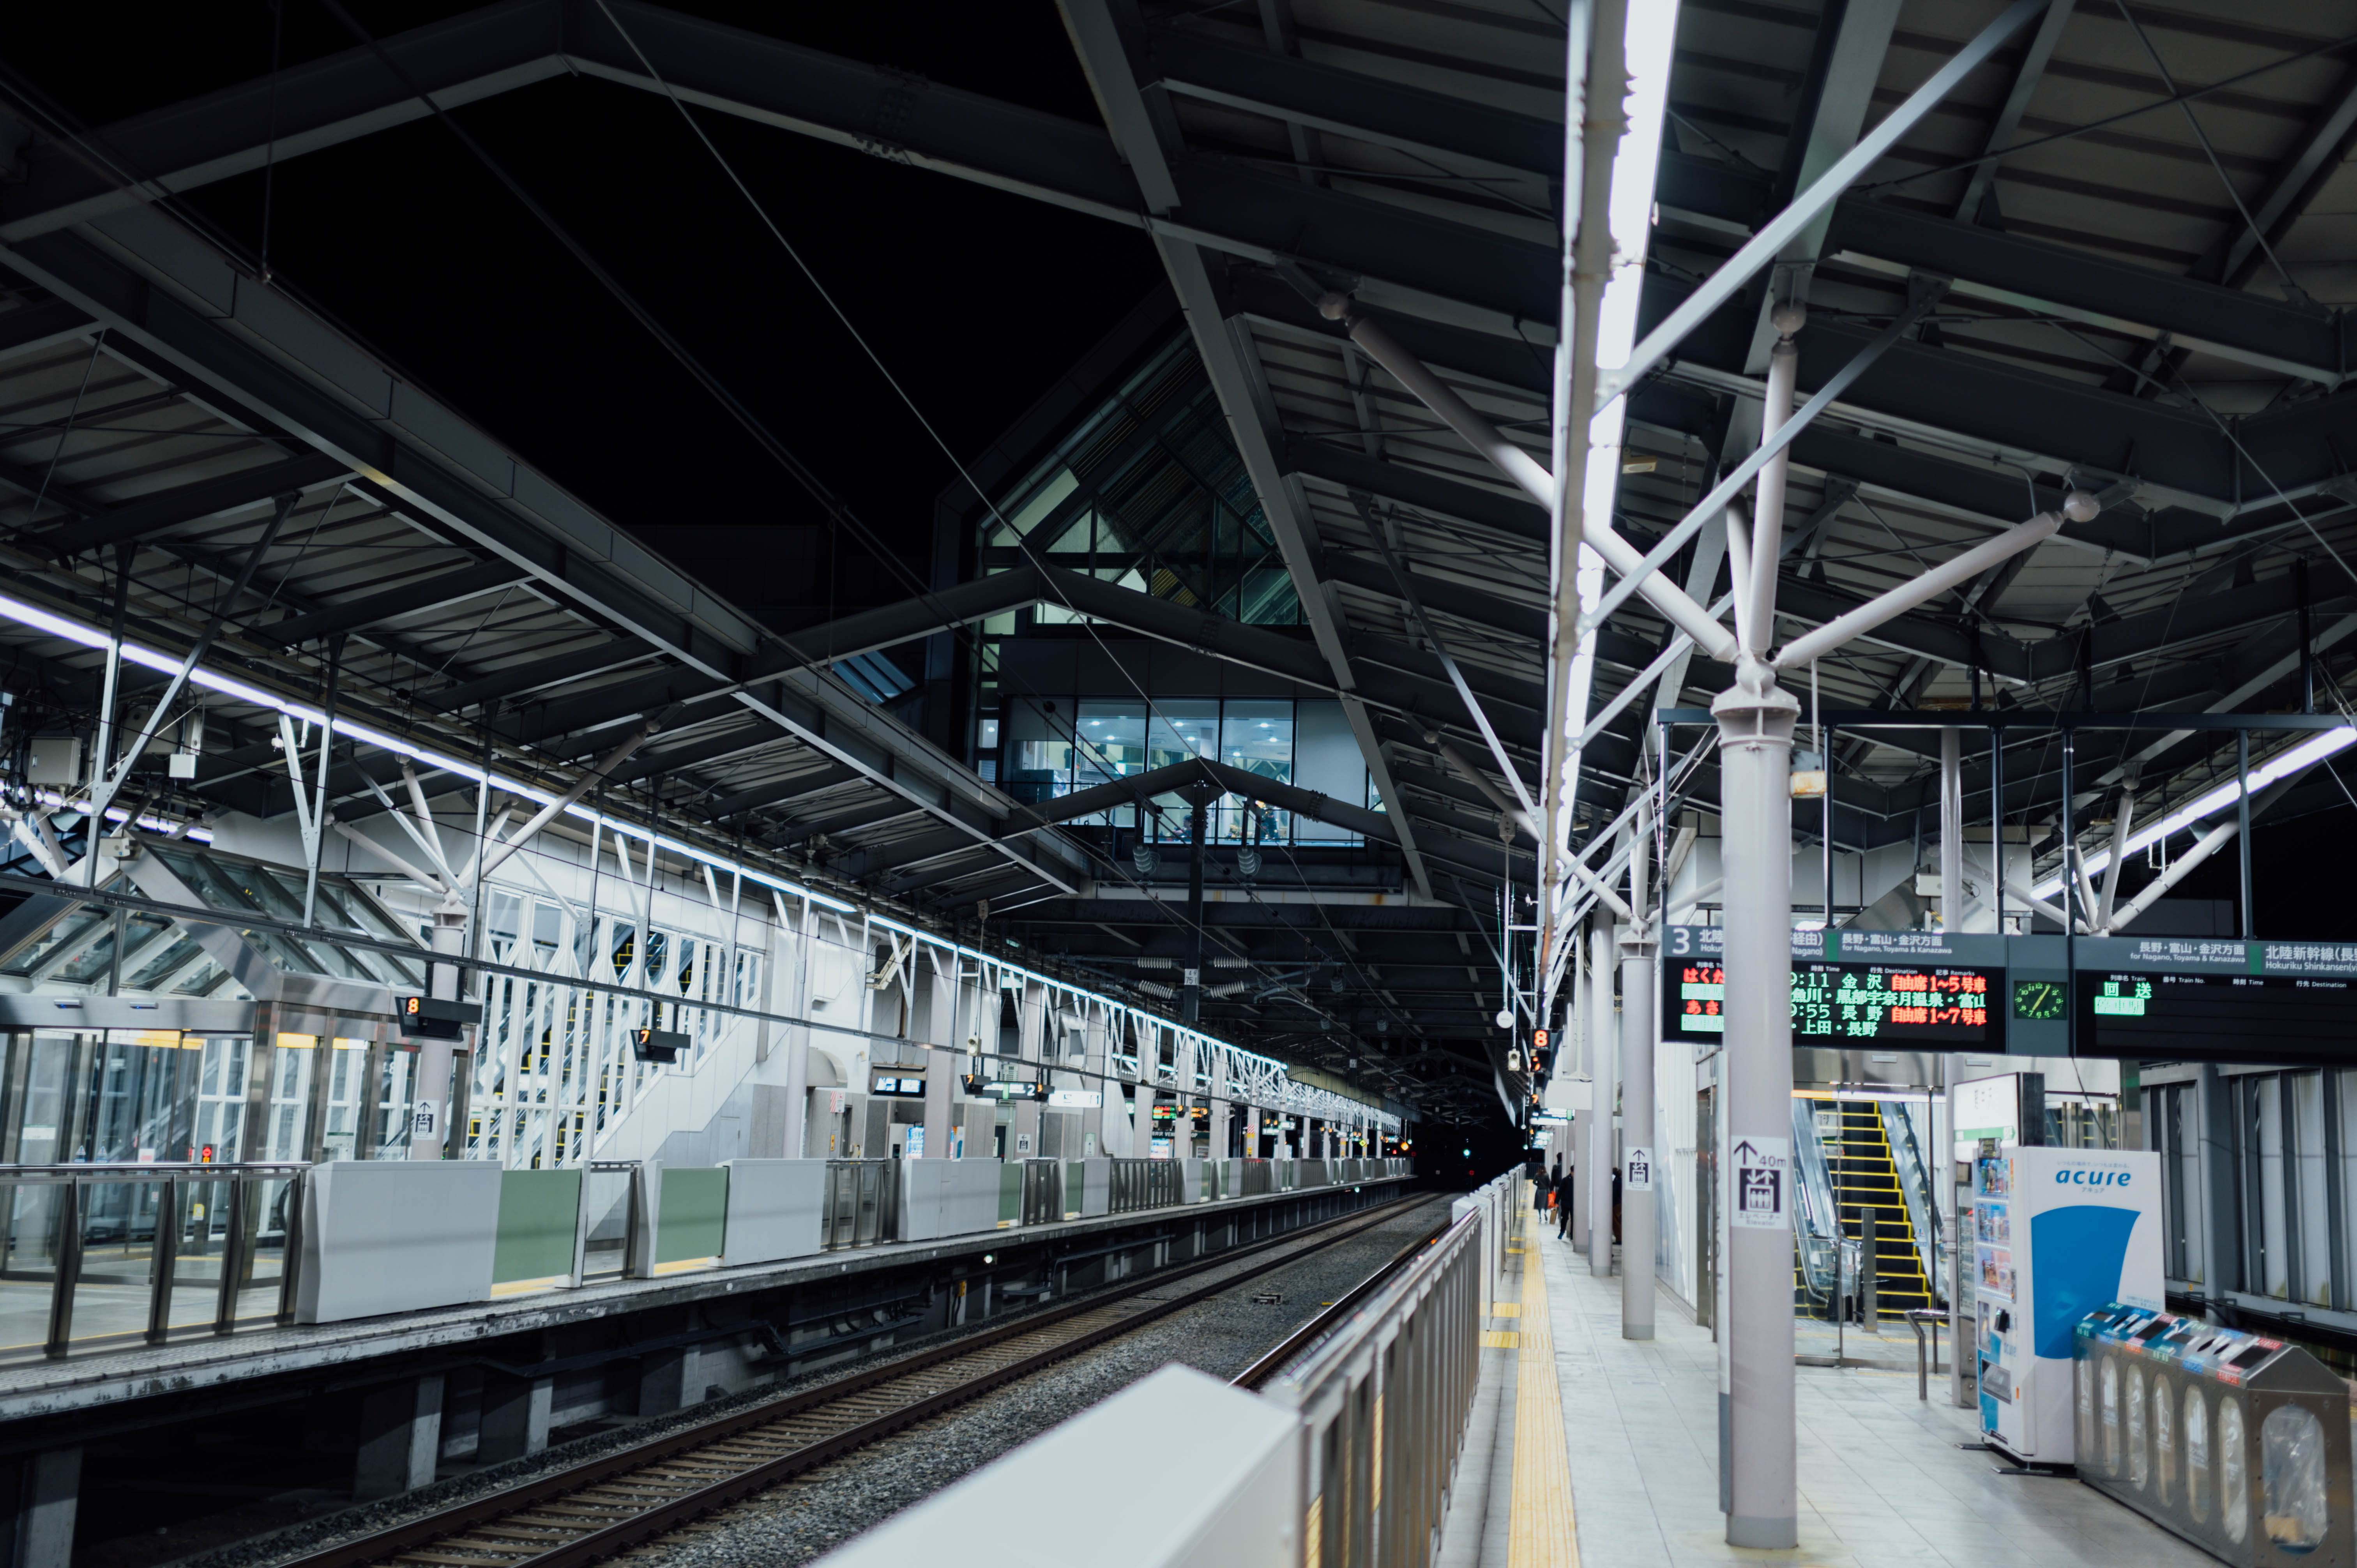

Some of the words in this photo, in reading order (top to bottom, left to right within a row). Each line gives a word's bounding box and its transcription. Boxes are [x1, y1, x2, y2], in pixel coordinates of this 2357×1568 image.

[1672, 927, 1690, 954] 3
[1790, 932, 1823, 946] 経由)
[1842, 933, 1942, 946] 長野・富山・金沢方面
[2140, 941, 2245, 955] 長野・富山・金沢方面
[2265, 945, 2357, 961] 北陸新幹線(長
[2265, 961, 2302, 970] Hokuriku
[408, 998, 419, 1013] 8
[640, 1030, 650, 1043] 7
[1534, 1030, 1548, 1047] 8
[967, 1074, 974, 1083] 7
[1027, 1084, 1035, 1096] 2
[1532, 1094, 1538, 1104] 7
[1758, 1155, 1786, 1167] 40m
[2055, 1170, 2131, 1187] acure
